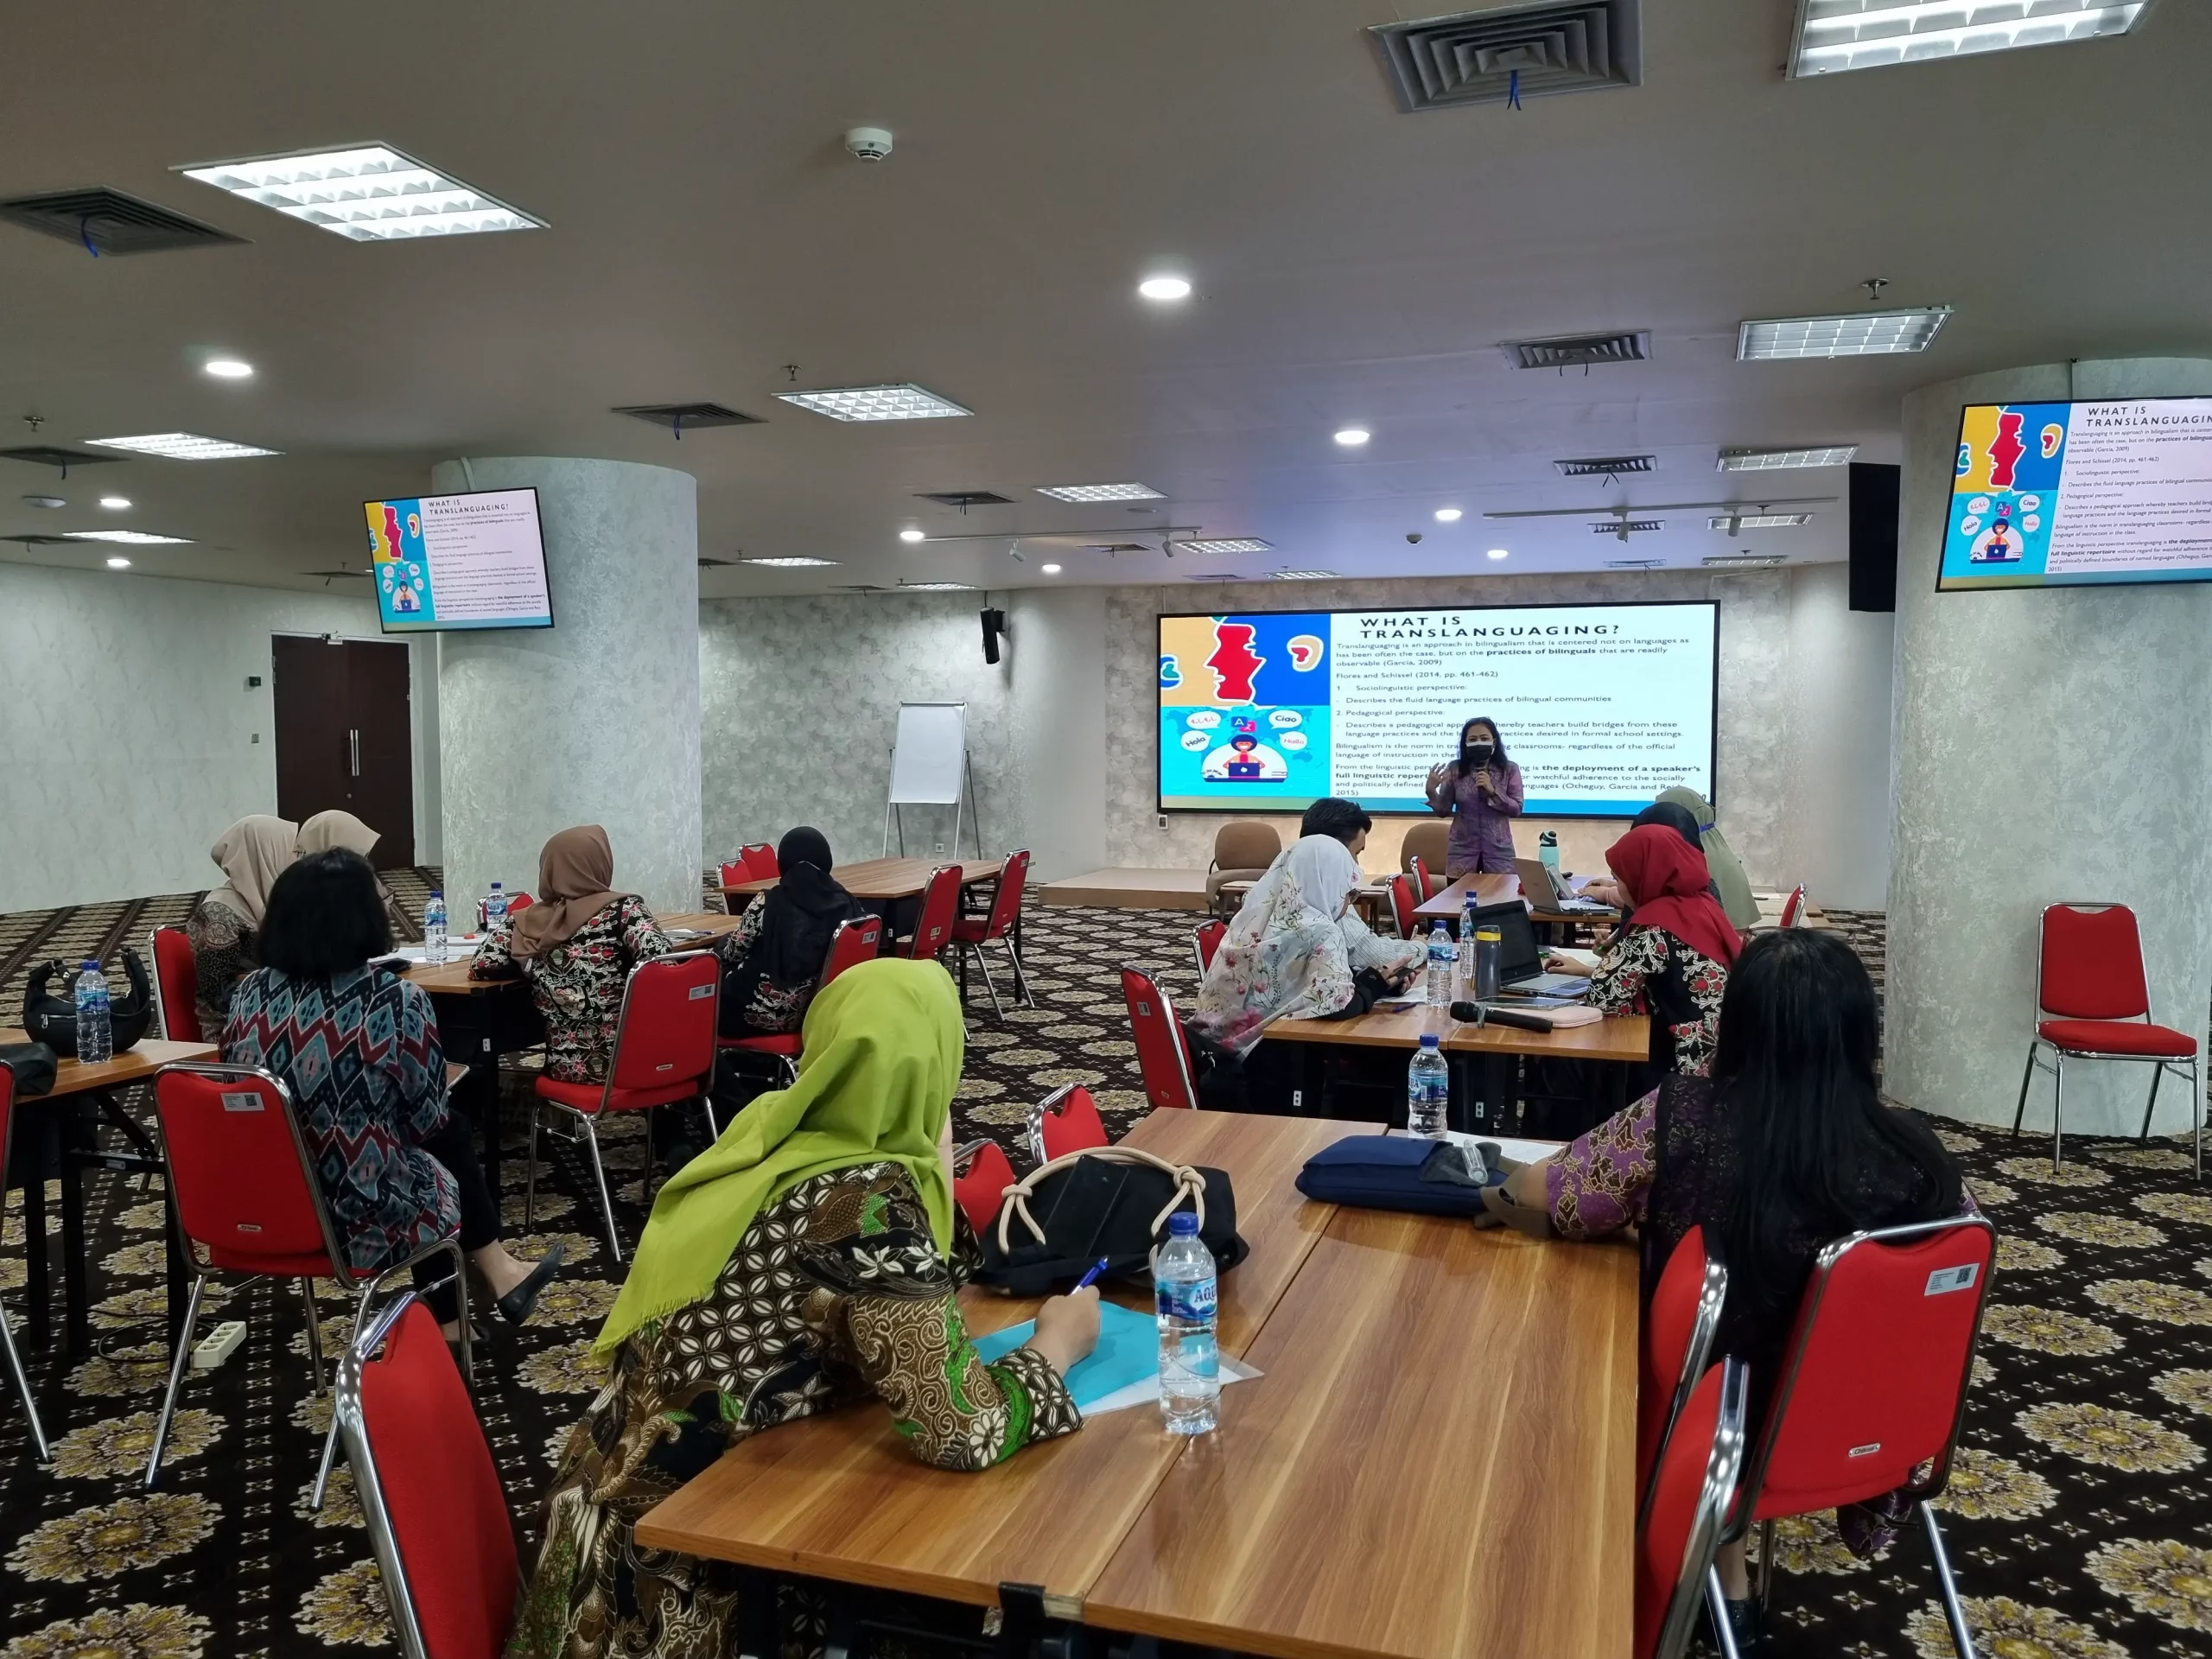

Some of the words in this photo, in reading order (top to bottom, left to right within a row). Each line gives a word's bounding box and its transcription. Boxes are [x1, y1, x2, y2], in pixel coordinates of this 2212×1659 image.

[2088, 407, 2128, 416] WHAT
[2134, 406, 2146, 415] IS
[1360, 618, 1429, 626] WHAT
[1442, 616, 1461, 626] IS
[1360, 626, 1619, 639] TRANSLANGUAGING?
[1423, 640, 1462, 649] approach
[1475, 639, 1525, 648] bilingualism
[1633, 637, 1676, 645] languages
[1185, 736, 1206, 747] Hola
